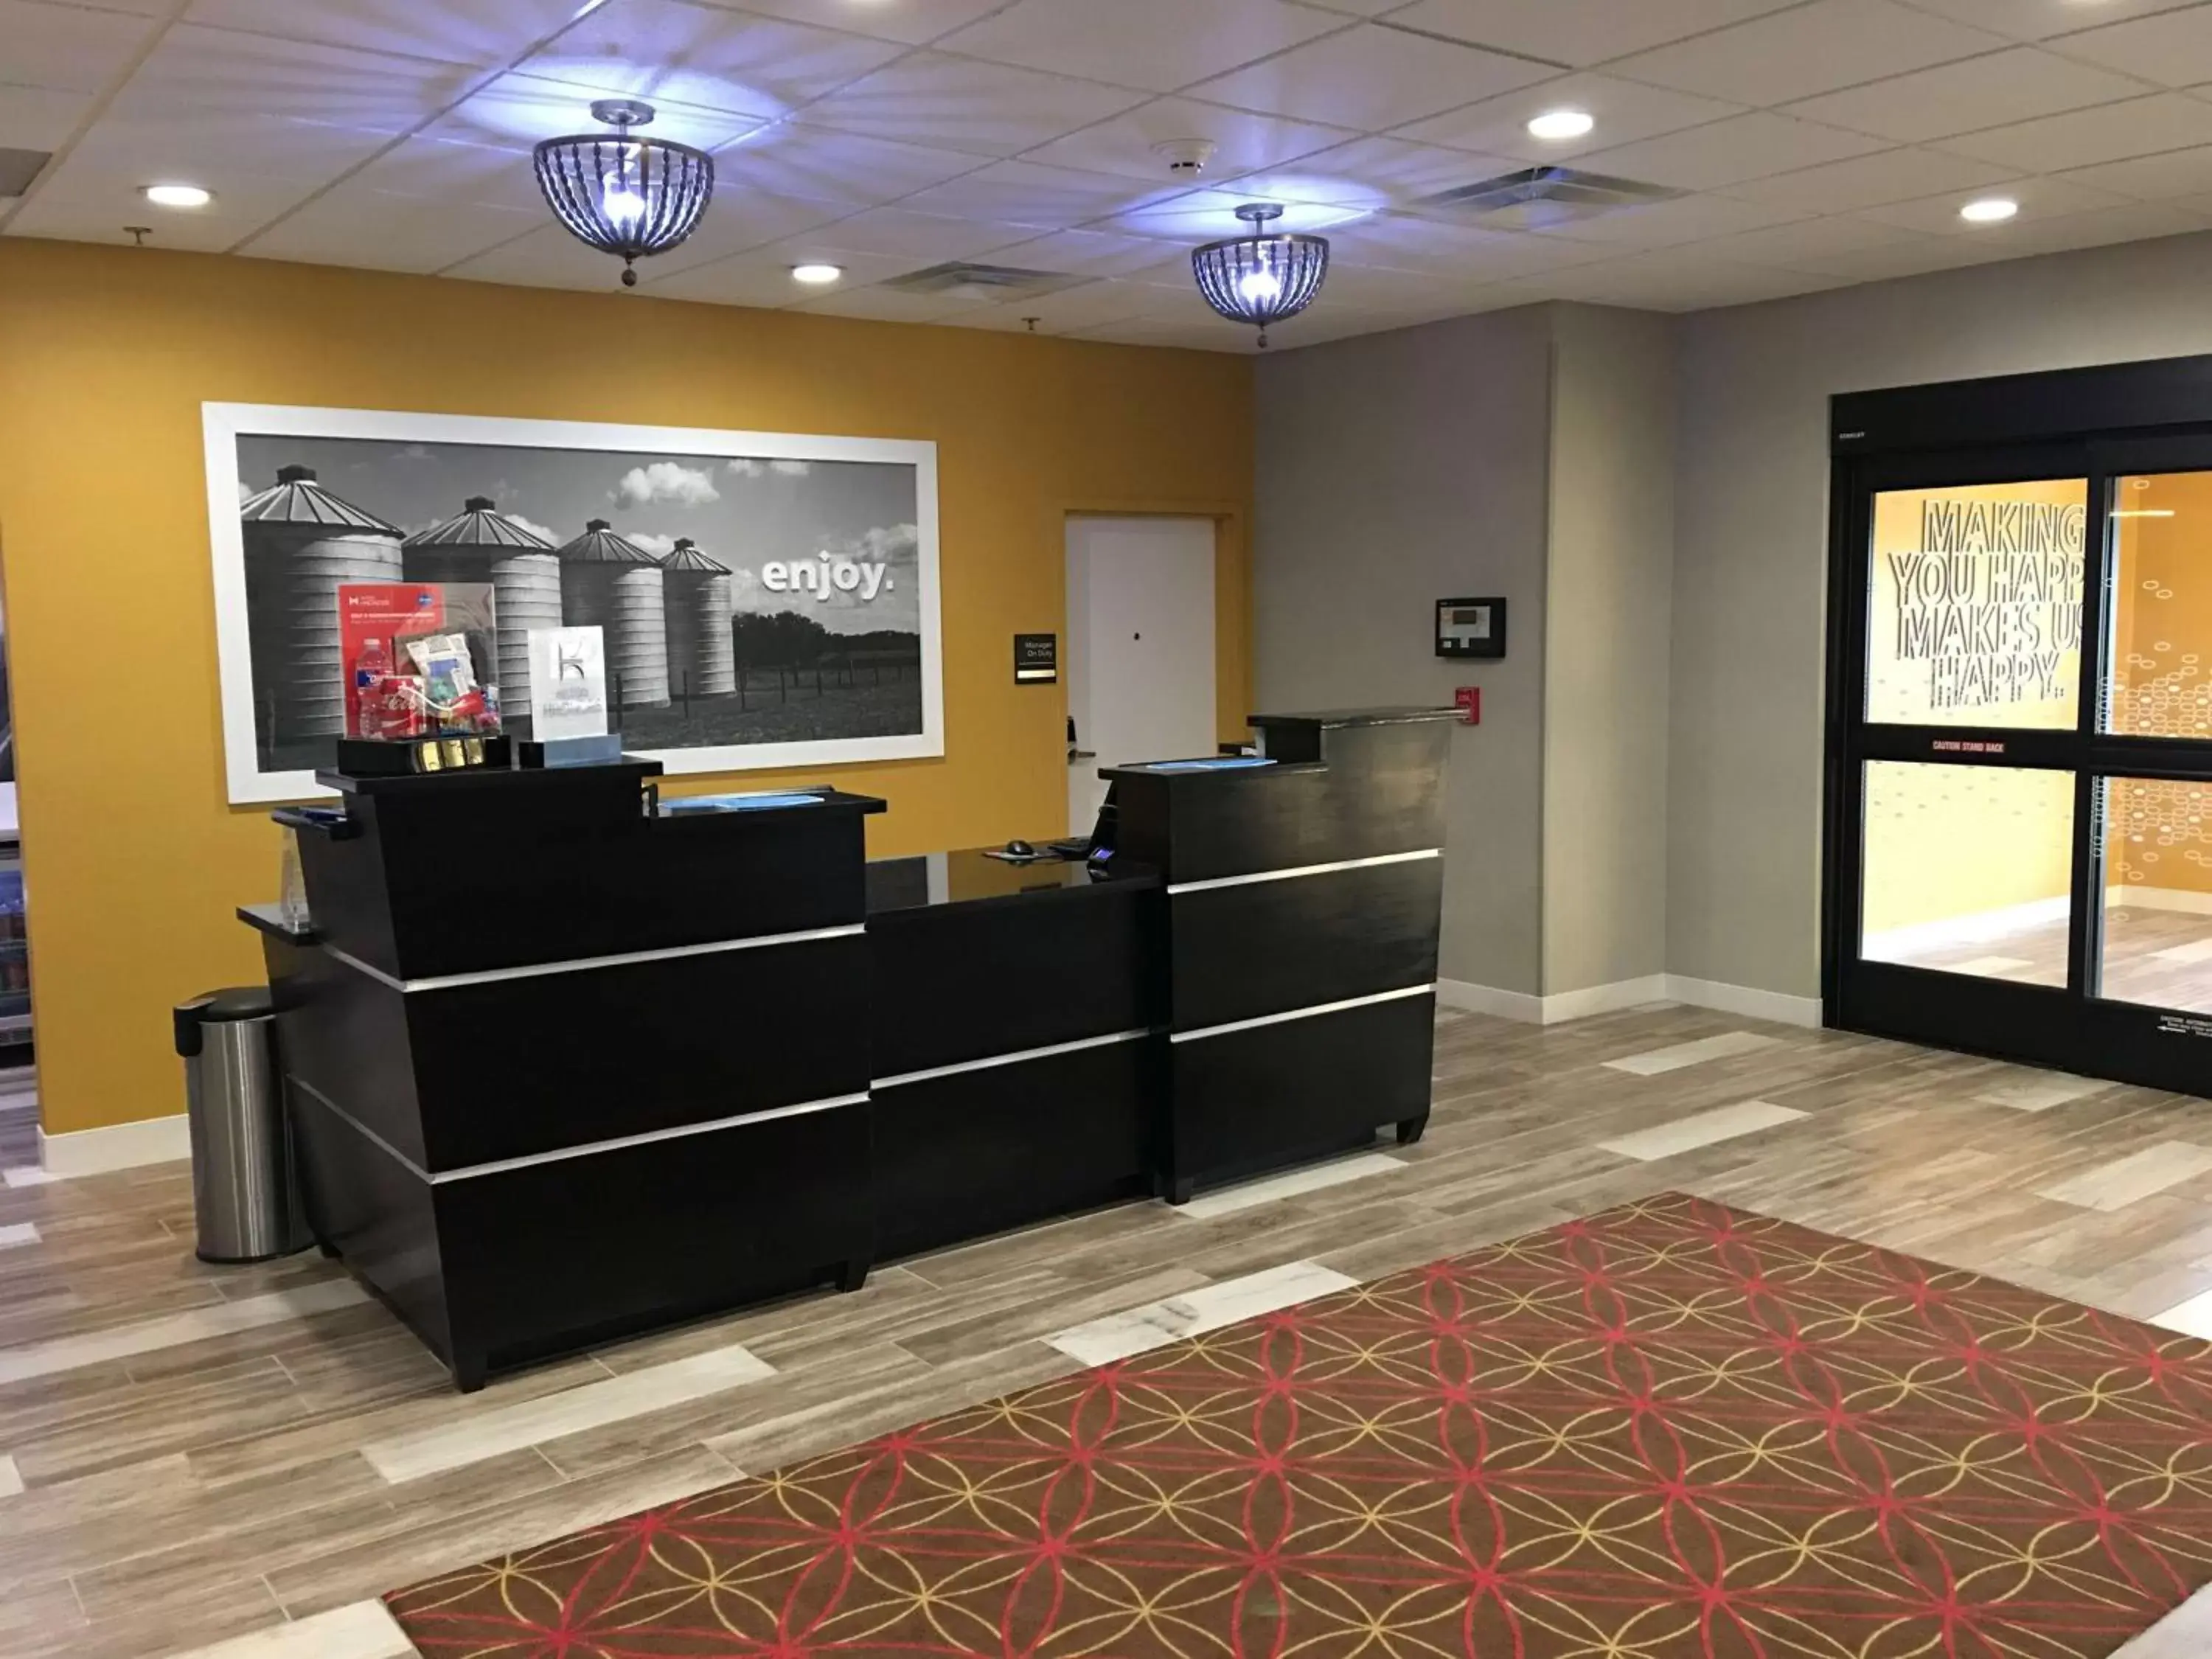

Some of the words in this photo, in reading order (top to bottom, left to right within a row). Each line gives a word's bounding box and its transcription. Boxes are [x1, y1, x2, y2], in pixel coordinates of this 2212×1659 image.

[1921, 500, 2085, 554] MAKING
[762, 550, 894, 602] enjoy.
[1888, 552, 1976, 608] YOU
[1988, 552, 2085, 604] HAPP
[1896, 602, 2041, 661] MAKES
[1930, 653, 2065, 709] HAPPY.
[1933, 740, 1961, 751] CAUTION
[1961, 741, 1984, 751] STAND
[1986, 742, 2004, 753] BACK
